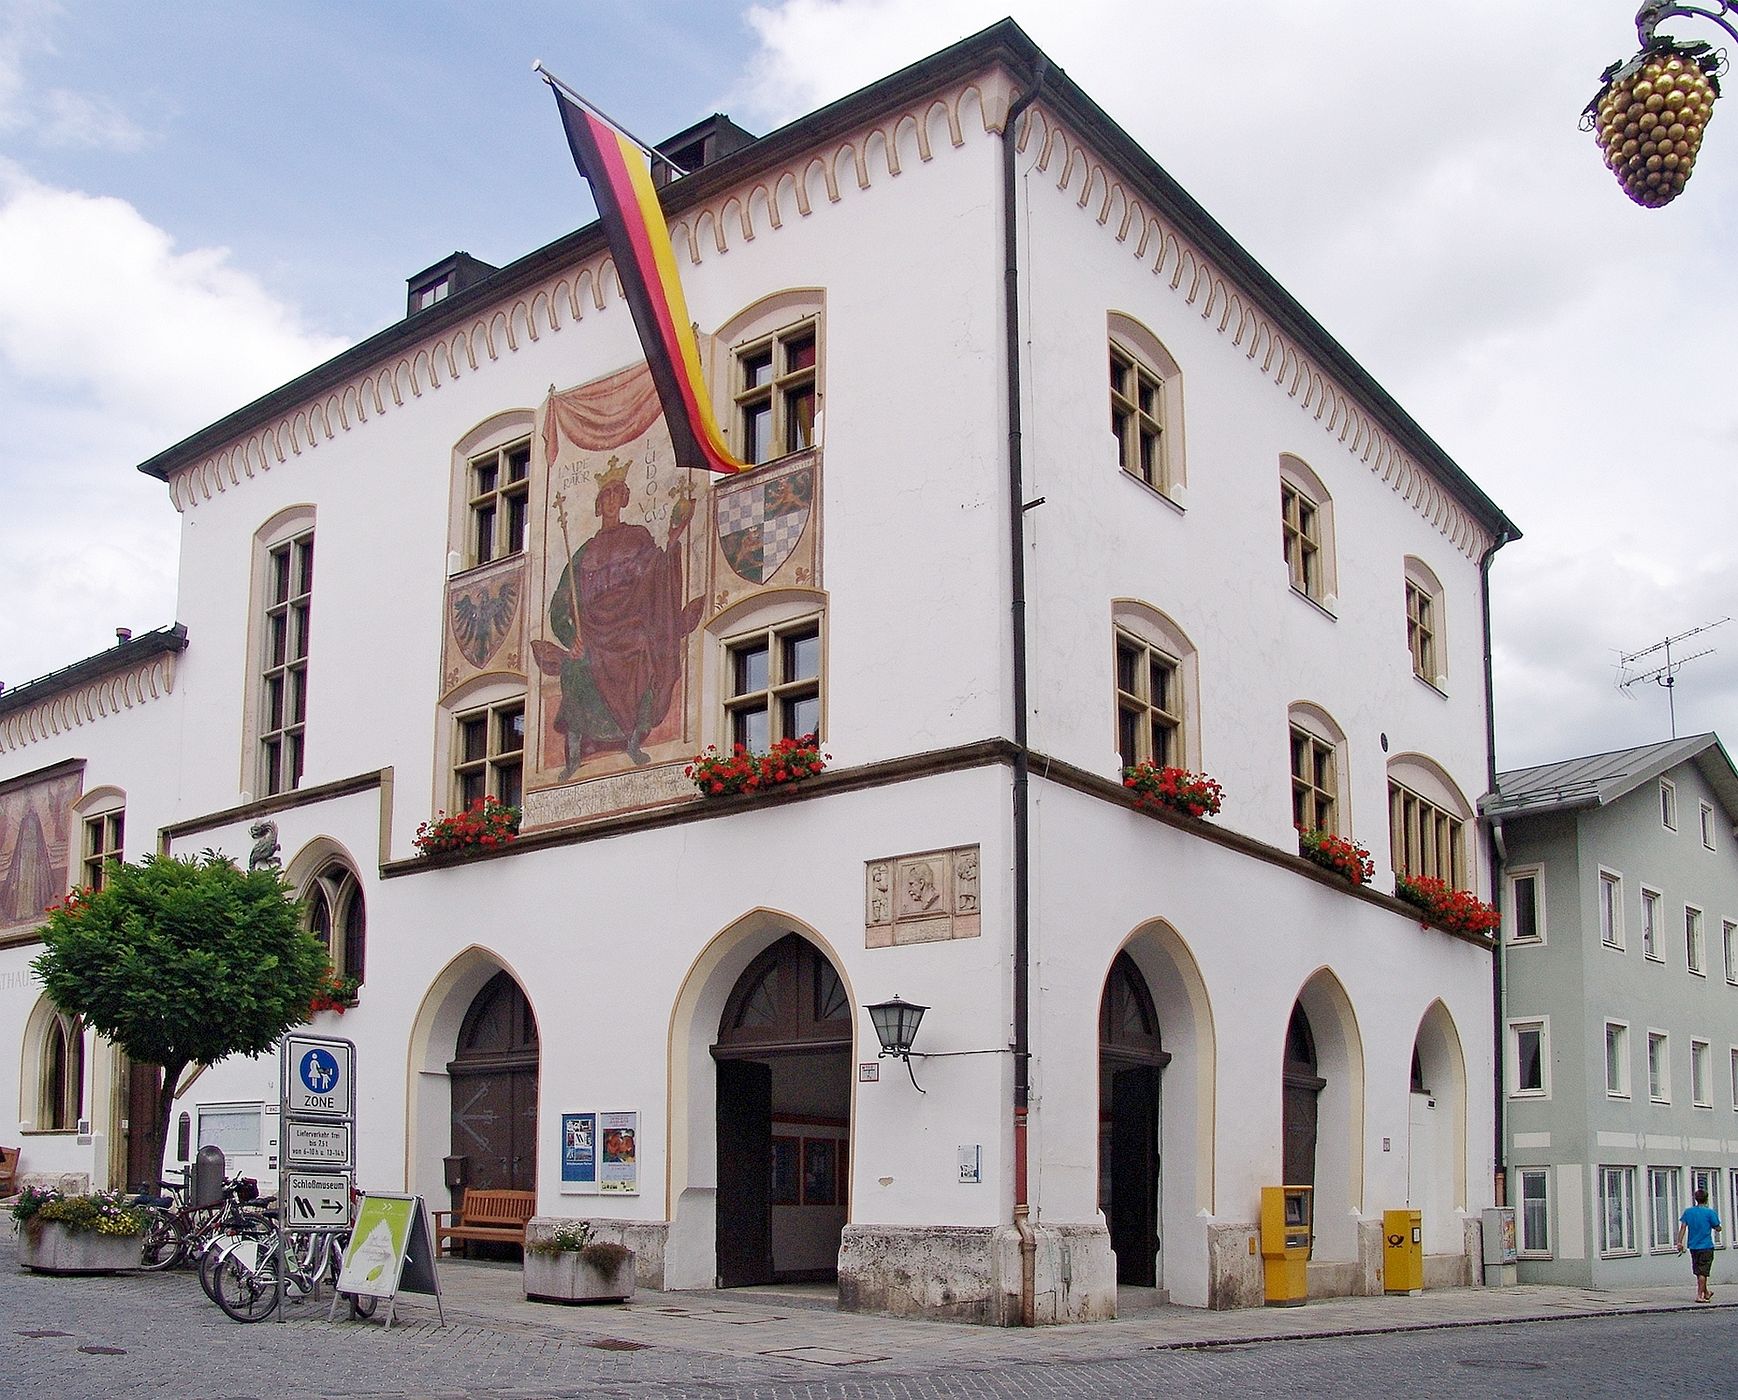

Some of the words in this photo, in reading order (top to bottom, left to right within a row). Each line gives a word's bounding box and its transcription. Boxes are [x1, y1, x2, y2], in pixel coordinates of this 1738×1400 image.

[304, 1095, 335, 1109] ZONE
[296, 1129, 330, 1138] Lieferverkehr
[309, 1139, 317, 1147] bis
[292, 1178, 345, 1190] Schloßmuseum
